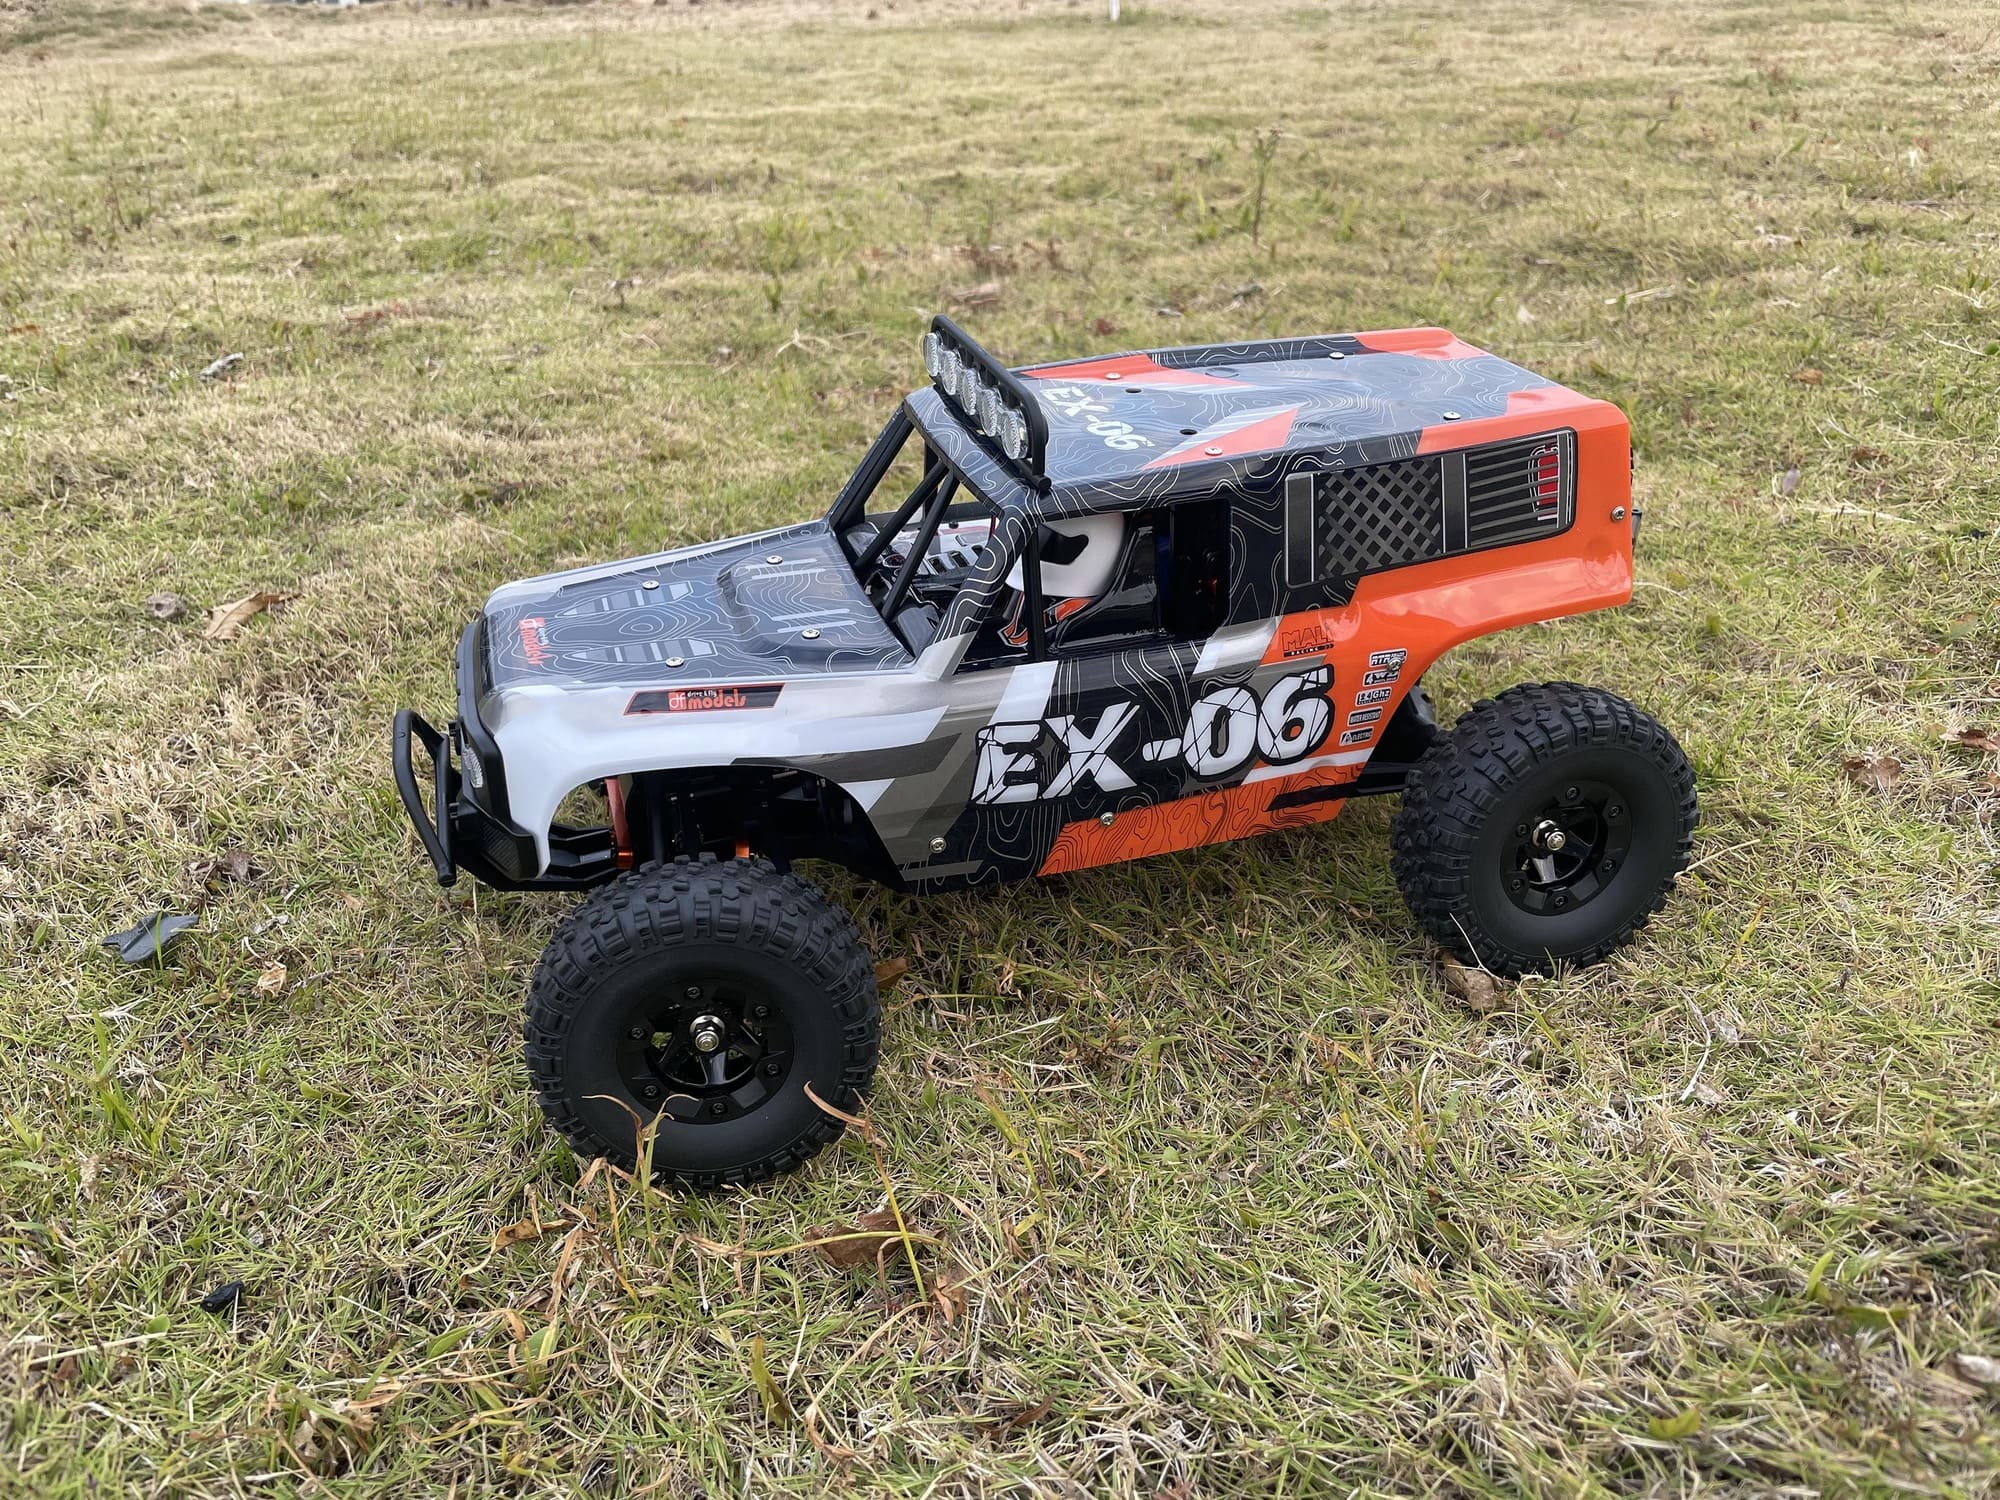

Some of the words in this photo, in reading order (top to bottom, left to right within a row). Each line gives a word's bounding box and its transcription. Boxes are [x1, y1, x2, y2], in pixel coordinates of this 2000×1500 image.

[1040, 386, 1155, 451] EX-06
[688, 688, 747, 709] models
[972, 665, 1333, 804] EX-06
